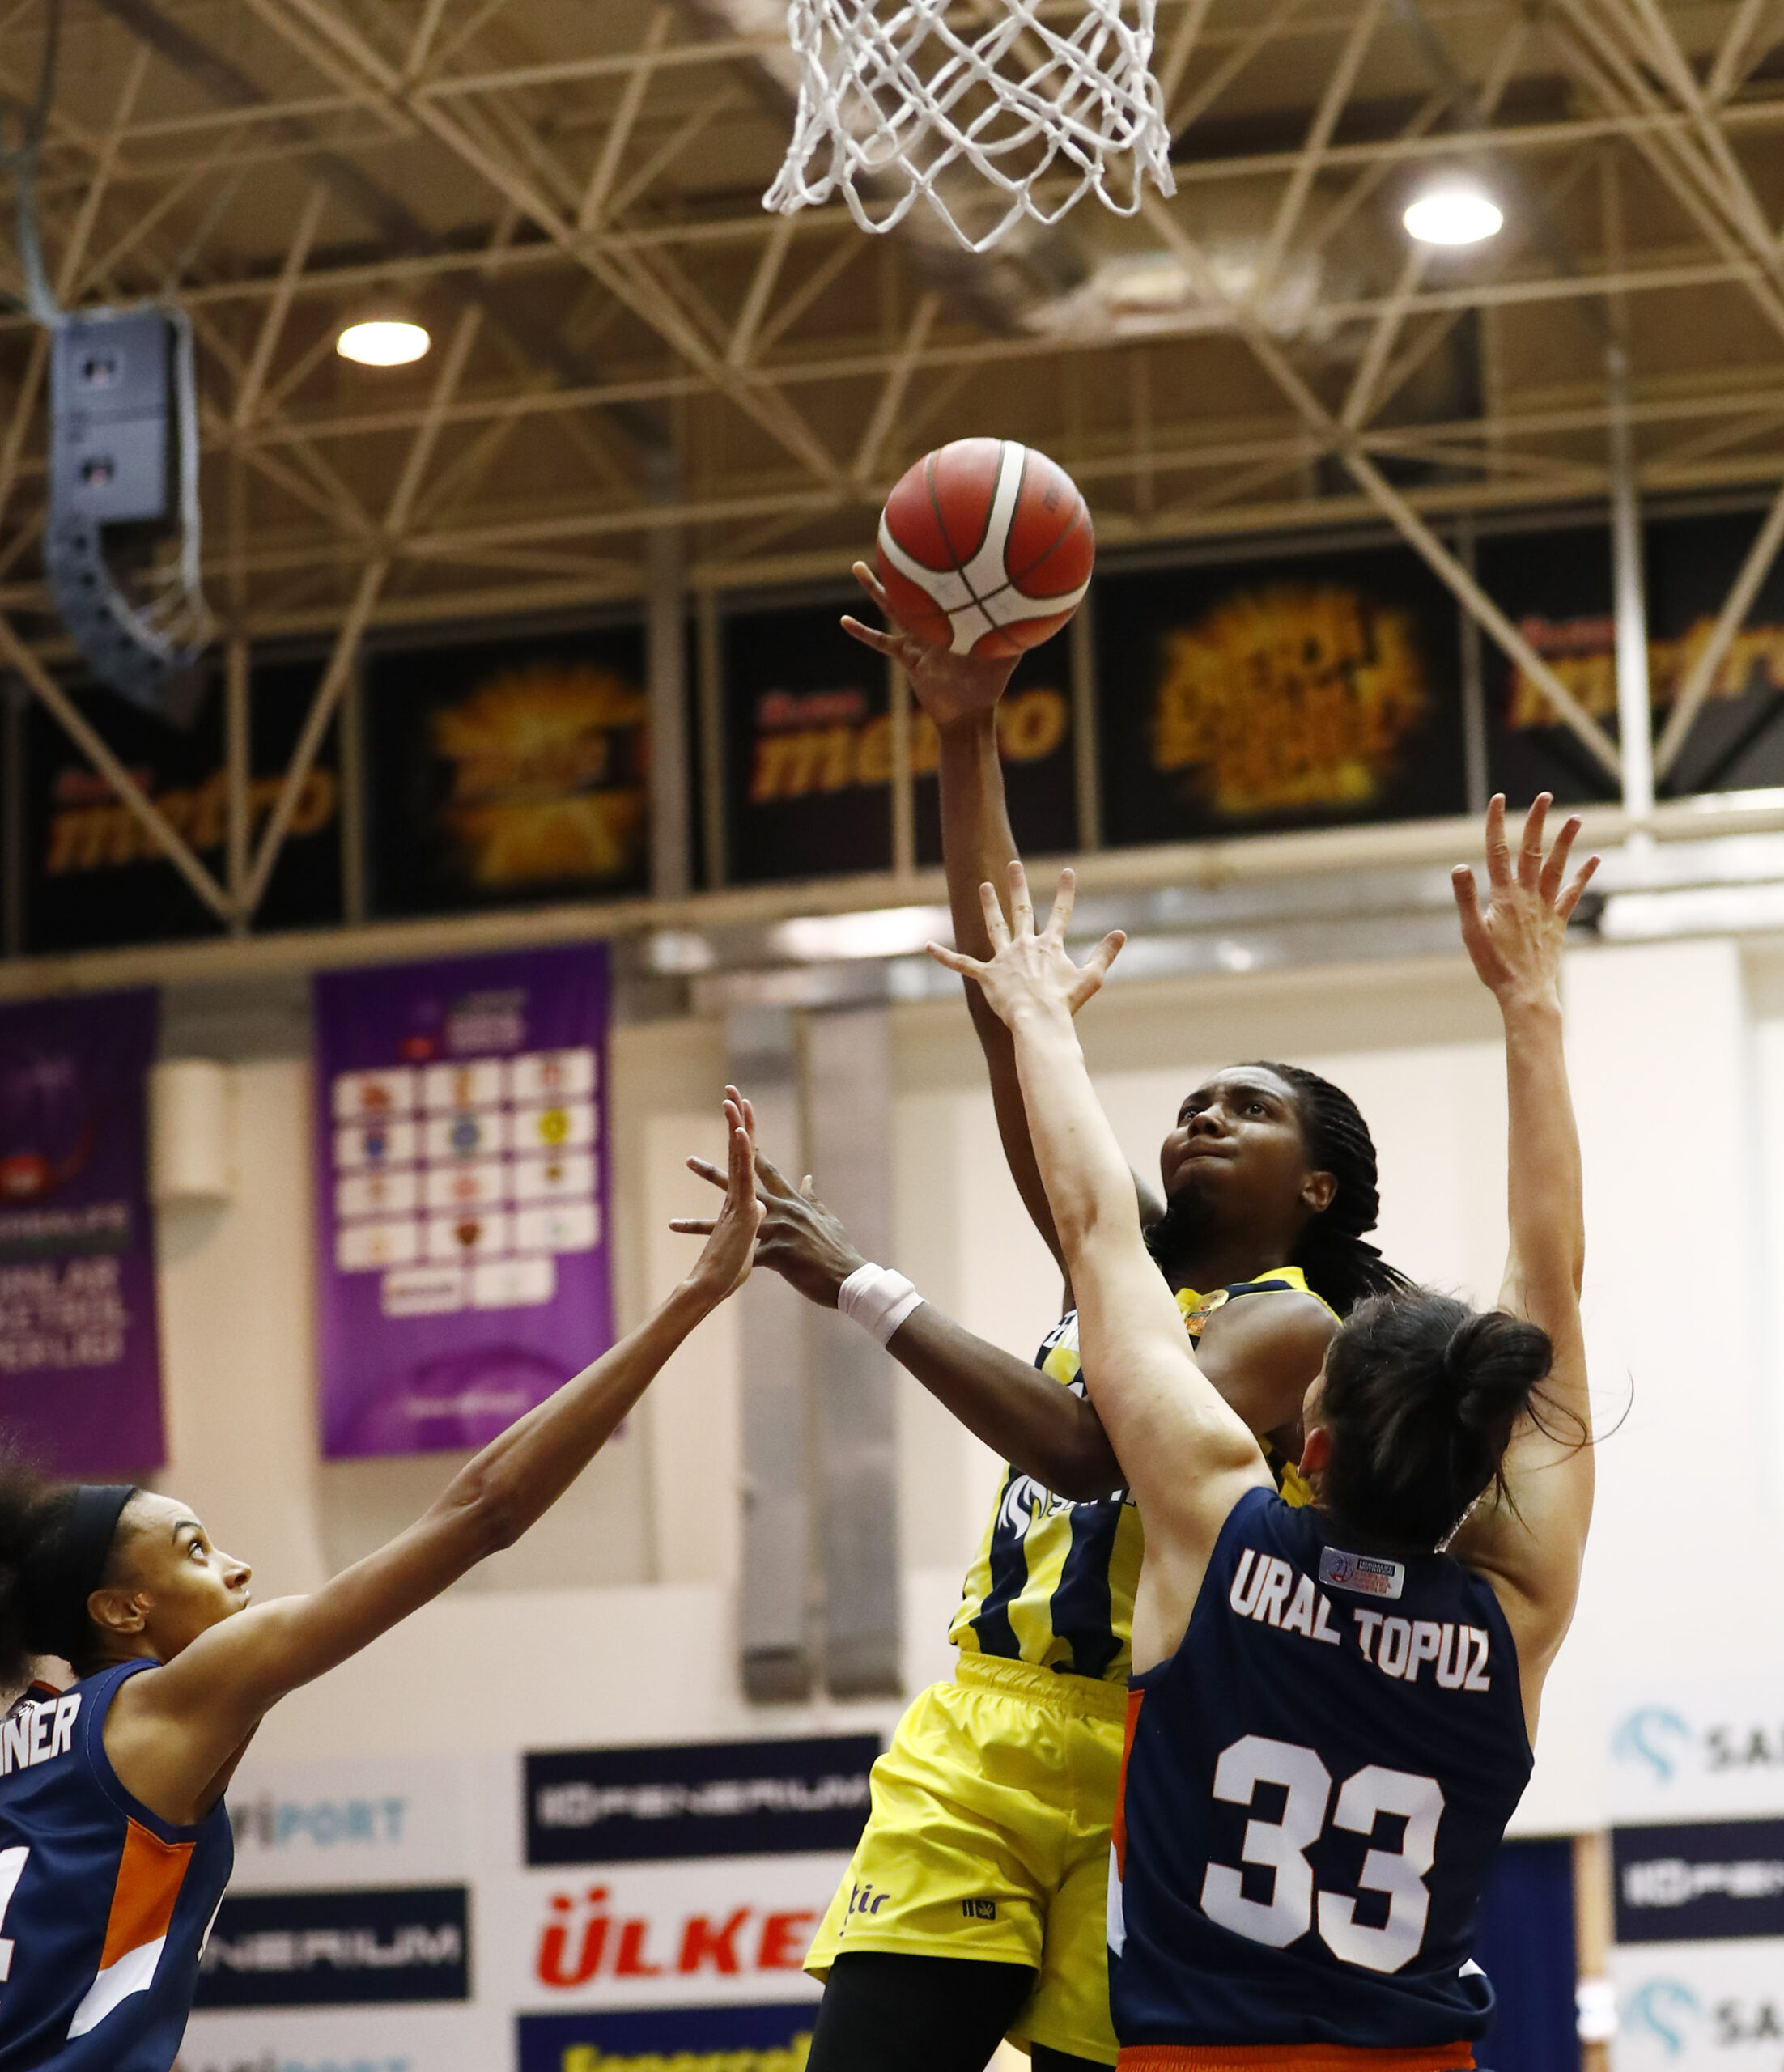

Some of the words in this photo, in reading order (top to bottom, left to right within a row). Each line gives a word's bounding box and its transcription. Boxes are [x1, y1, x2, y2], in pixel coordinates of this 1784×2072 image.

[1229, 1548, 1342, 1645] URAL
[1353, 1607, 1491, 1692] TOPUZ
[0, 1692, 83, 1778] NER
[1200, 1733, 1446, 1975] 33
